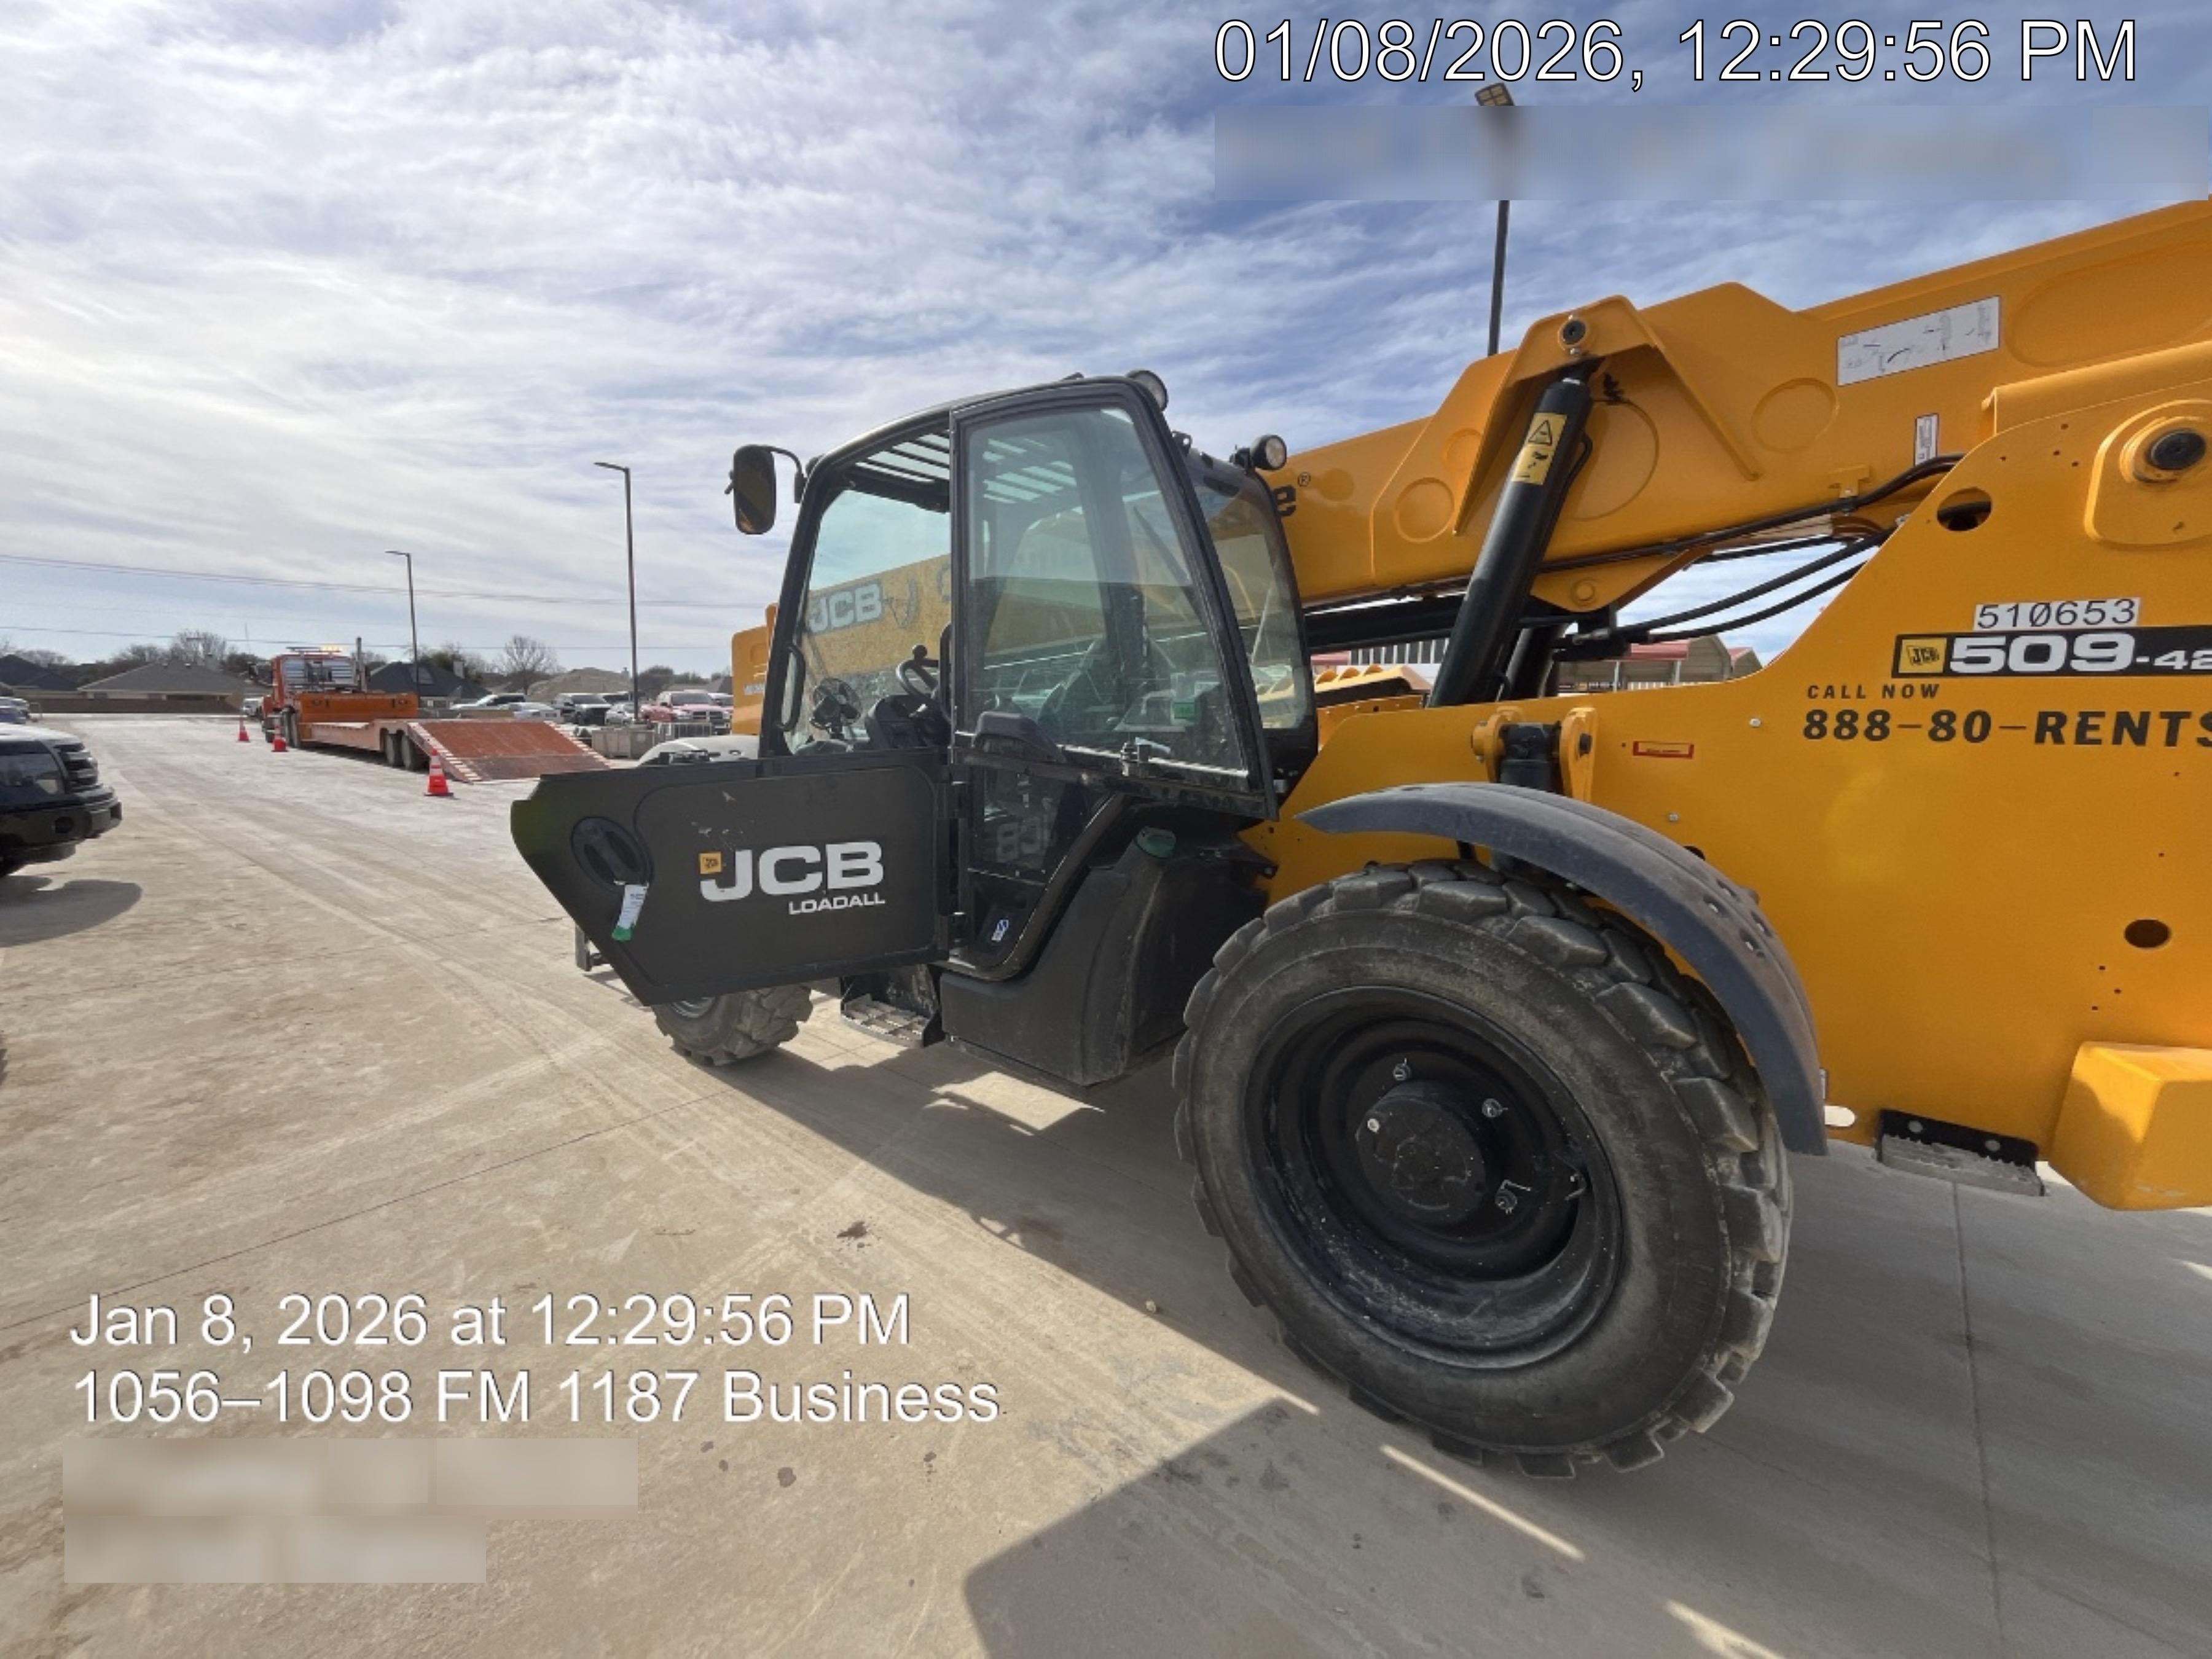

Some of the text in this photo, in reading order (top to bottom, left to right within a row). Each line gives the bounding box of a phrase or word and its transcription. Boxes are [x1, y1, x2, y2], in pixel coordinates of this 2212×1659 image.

[808, 584, 882, 634] JCB
[1976, 598, 2136, 629] 510653
[1807, 683, 1940, 699] CALL NOW
[699, 841, 884, 902] JCB
[787, 892, 885, 915] LOADALL
